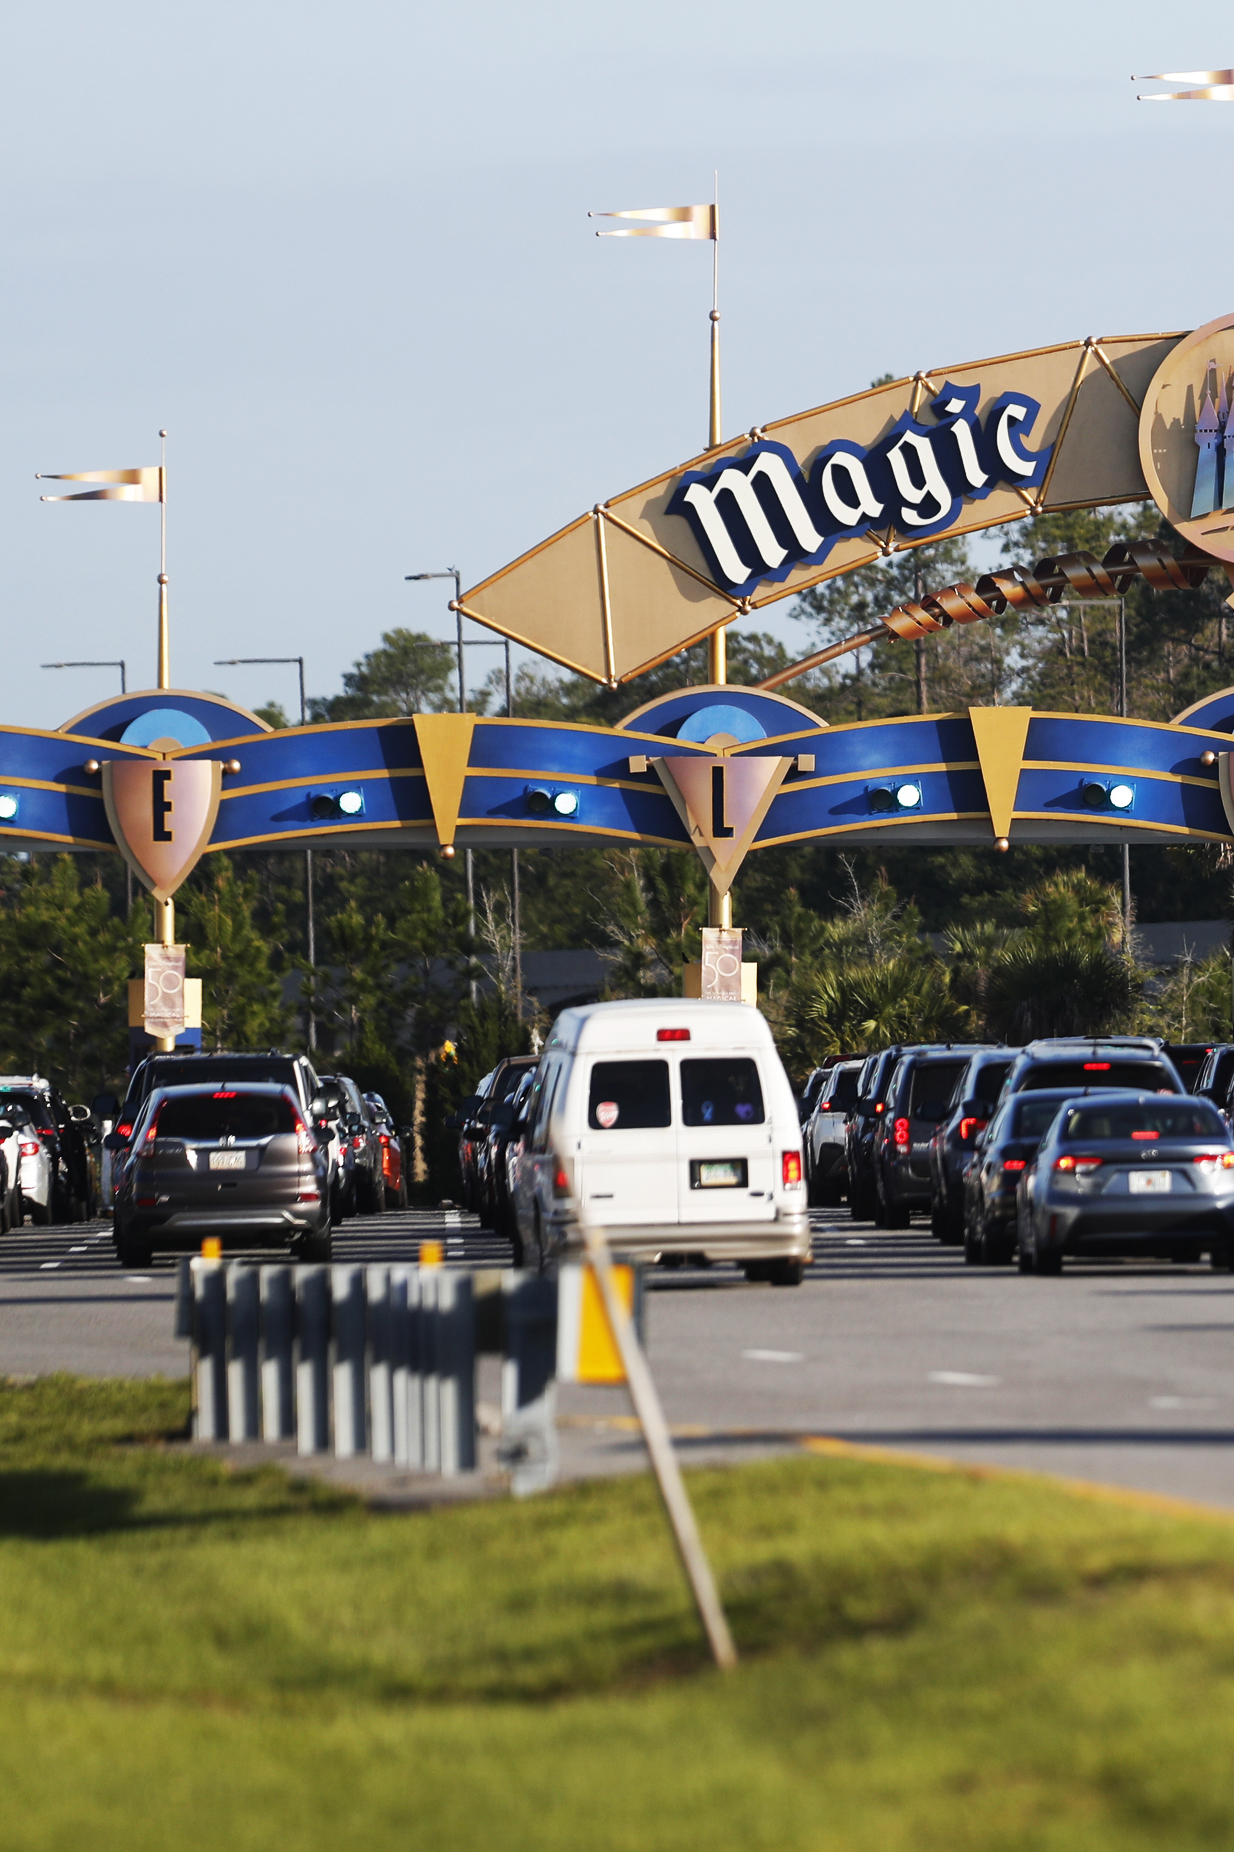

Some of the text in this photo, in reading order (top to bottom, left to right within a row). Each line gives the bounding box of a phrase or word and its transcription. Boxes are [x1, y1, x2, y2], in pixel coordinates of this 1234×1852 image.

[683, 397, 1037, 585] Magic
[152, 769, 172, 841] E
[711, 765, 735, 838] L
[148, 968, 183, 1004] 50
[705, 951, 739, 988] 50
